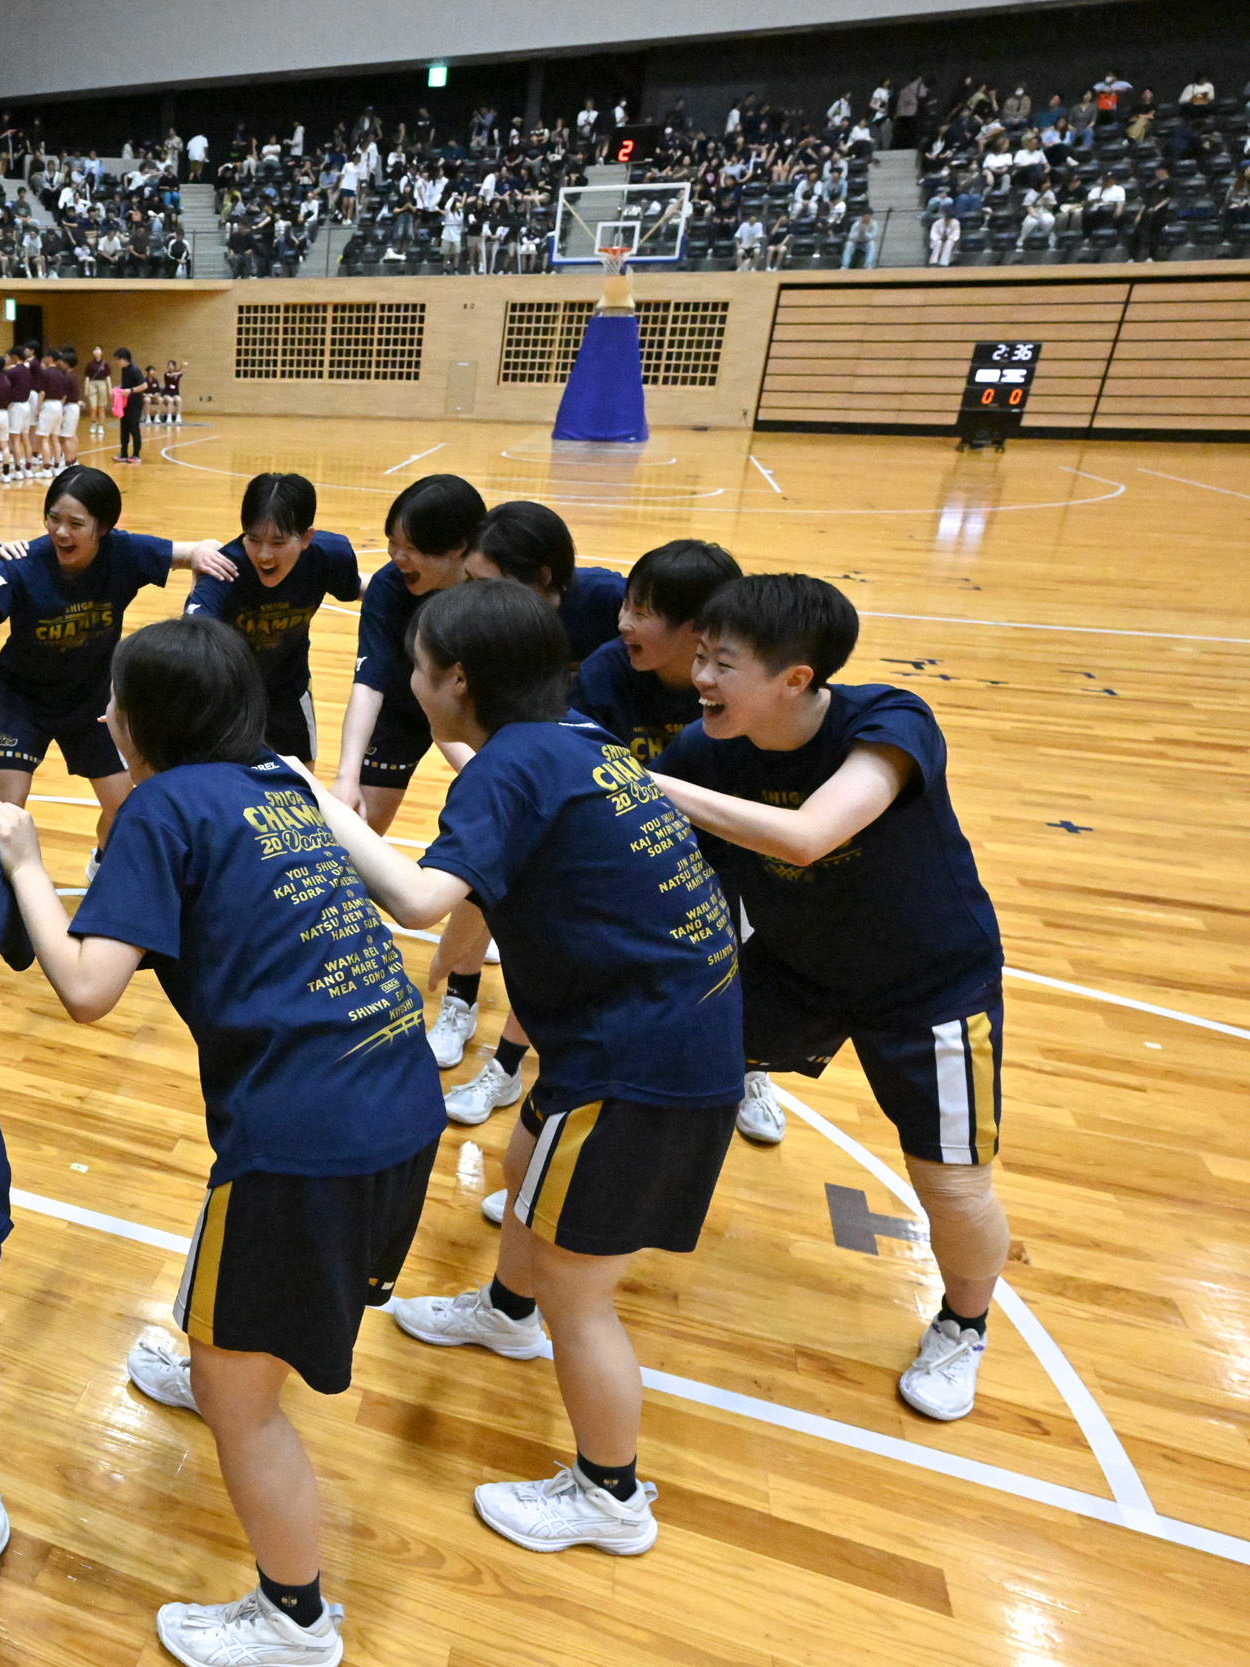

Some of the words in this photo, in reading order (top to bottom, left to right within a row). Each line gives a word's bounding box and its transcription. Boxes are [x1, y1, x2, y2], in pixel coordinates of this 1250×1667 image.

[618, 140, 634, 162] 2
[992, 344, 1034, 360] 2:36
[982, 388, 995, 404] 0
[1009, 389, 1023, 404] 0
[265, 790, 305, 806] SHIGA
[611, 793, 631, 811] 20
[640, 818, 661, 834] YOU
[261, 838, 282, 854] 20
[630, 836, 651, 852] KAI
[648, 838, 674, 857] SORA
[286, 867, 309, 881] YOU
[677, 858, 688, 872] JIN
[273, 886, 296, 899] KAI
[302, 874, 327, 889] MIRI
[658, 870, 691, 893] NATSU
[291, 887, 325, 905] SORA
[321, 906, 339, 920] JIN
[300, 918, 339, 942] NATSU
[344, 910, 363, 924] REN
[332, 926, 360, 941] HAKU
[364, 917, 379, 930] SUA
[670, 919, 702, 939] TANO
[689, 927, 713, 944] MEA
[325, 950, 360, 973] WAKA
[363, 946, 379, 959] REI
[307, 971, 345, 992] TANO
[351, 960, 378, 976] MARE
[328, 983, 357, 998] MEA
[363, 972, 385, 986] SONO
[348, 998, 391, 1022] SHINYA
